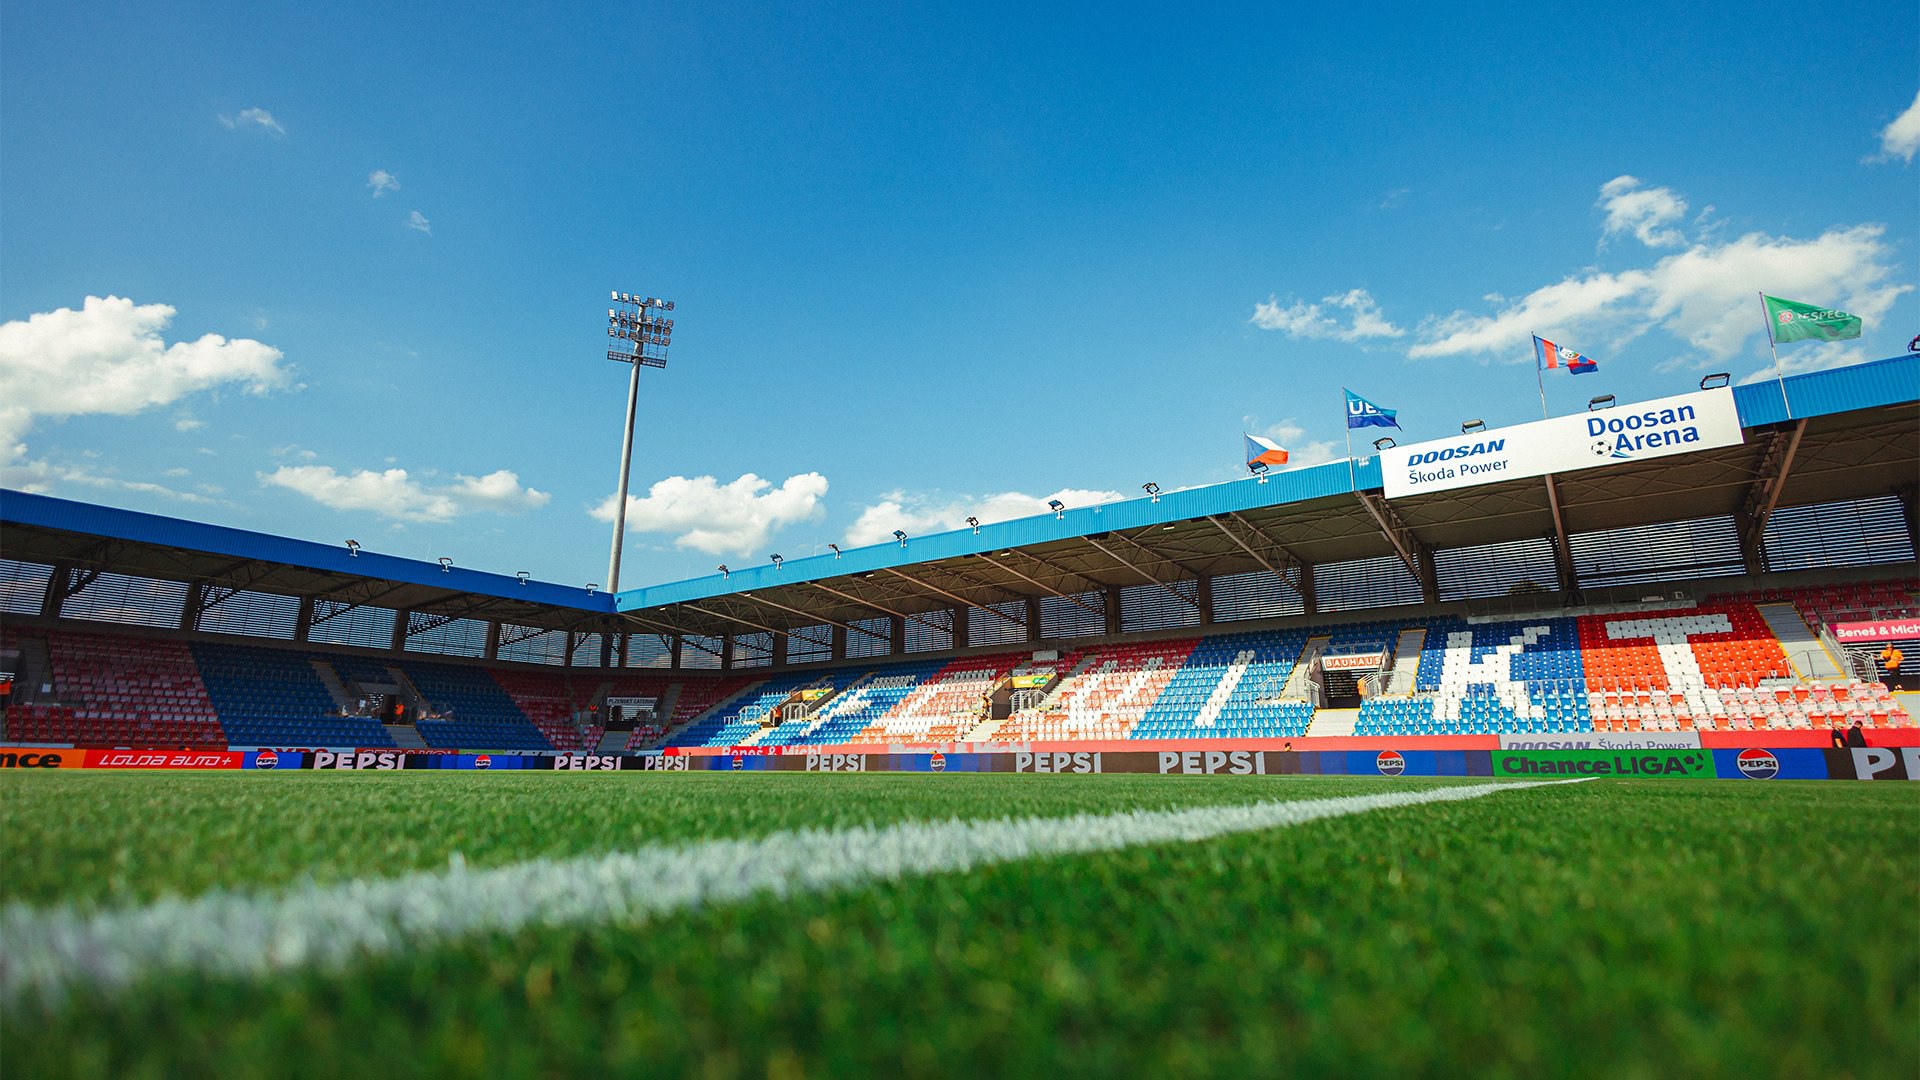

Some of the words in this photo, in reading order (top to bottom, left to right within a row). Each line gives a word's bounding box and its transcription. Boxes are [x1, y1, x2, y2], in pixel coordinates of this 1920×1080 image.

[1797, 311, 1849, 321] ESPEC
[1587, 404, 1695, 437] Doosan
[1615, 424, 1700, 453] Arena
[1407, 439, 1505, 467] DOOSAN
[1409, 467, 1455, 485] Škoda
[1460, 458, 1509, 477] Power
[1836, 627, 1876, 638] Beneš
[1879, 626, 1889, 635] &
[1325, 656, 1381, 668] BAUHAUS
[1598, 739, 1642, 750] Škoda
[1646, 741, 1692, 750] Power
[313, 752, 405, 770] PEPSI
[554, 756, 622, 771] PEPSI
[644, 756, 690, 771] PEPSI
[806, 753, 866, 772] PEPSI
[1016, 752, 1101, 773] PEPSI
[1159, 751, 1265, 775] PEPSI
[1378, 759, 1404, 767] PEPSI
[1502, 756, 1611, 775] Chance
[1614, 757, 1689, 775] LIGA
[1739, 760, 1777, 768] PEPSI
